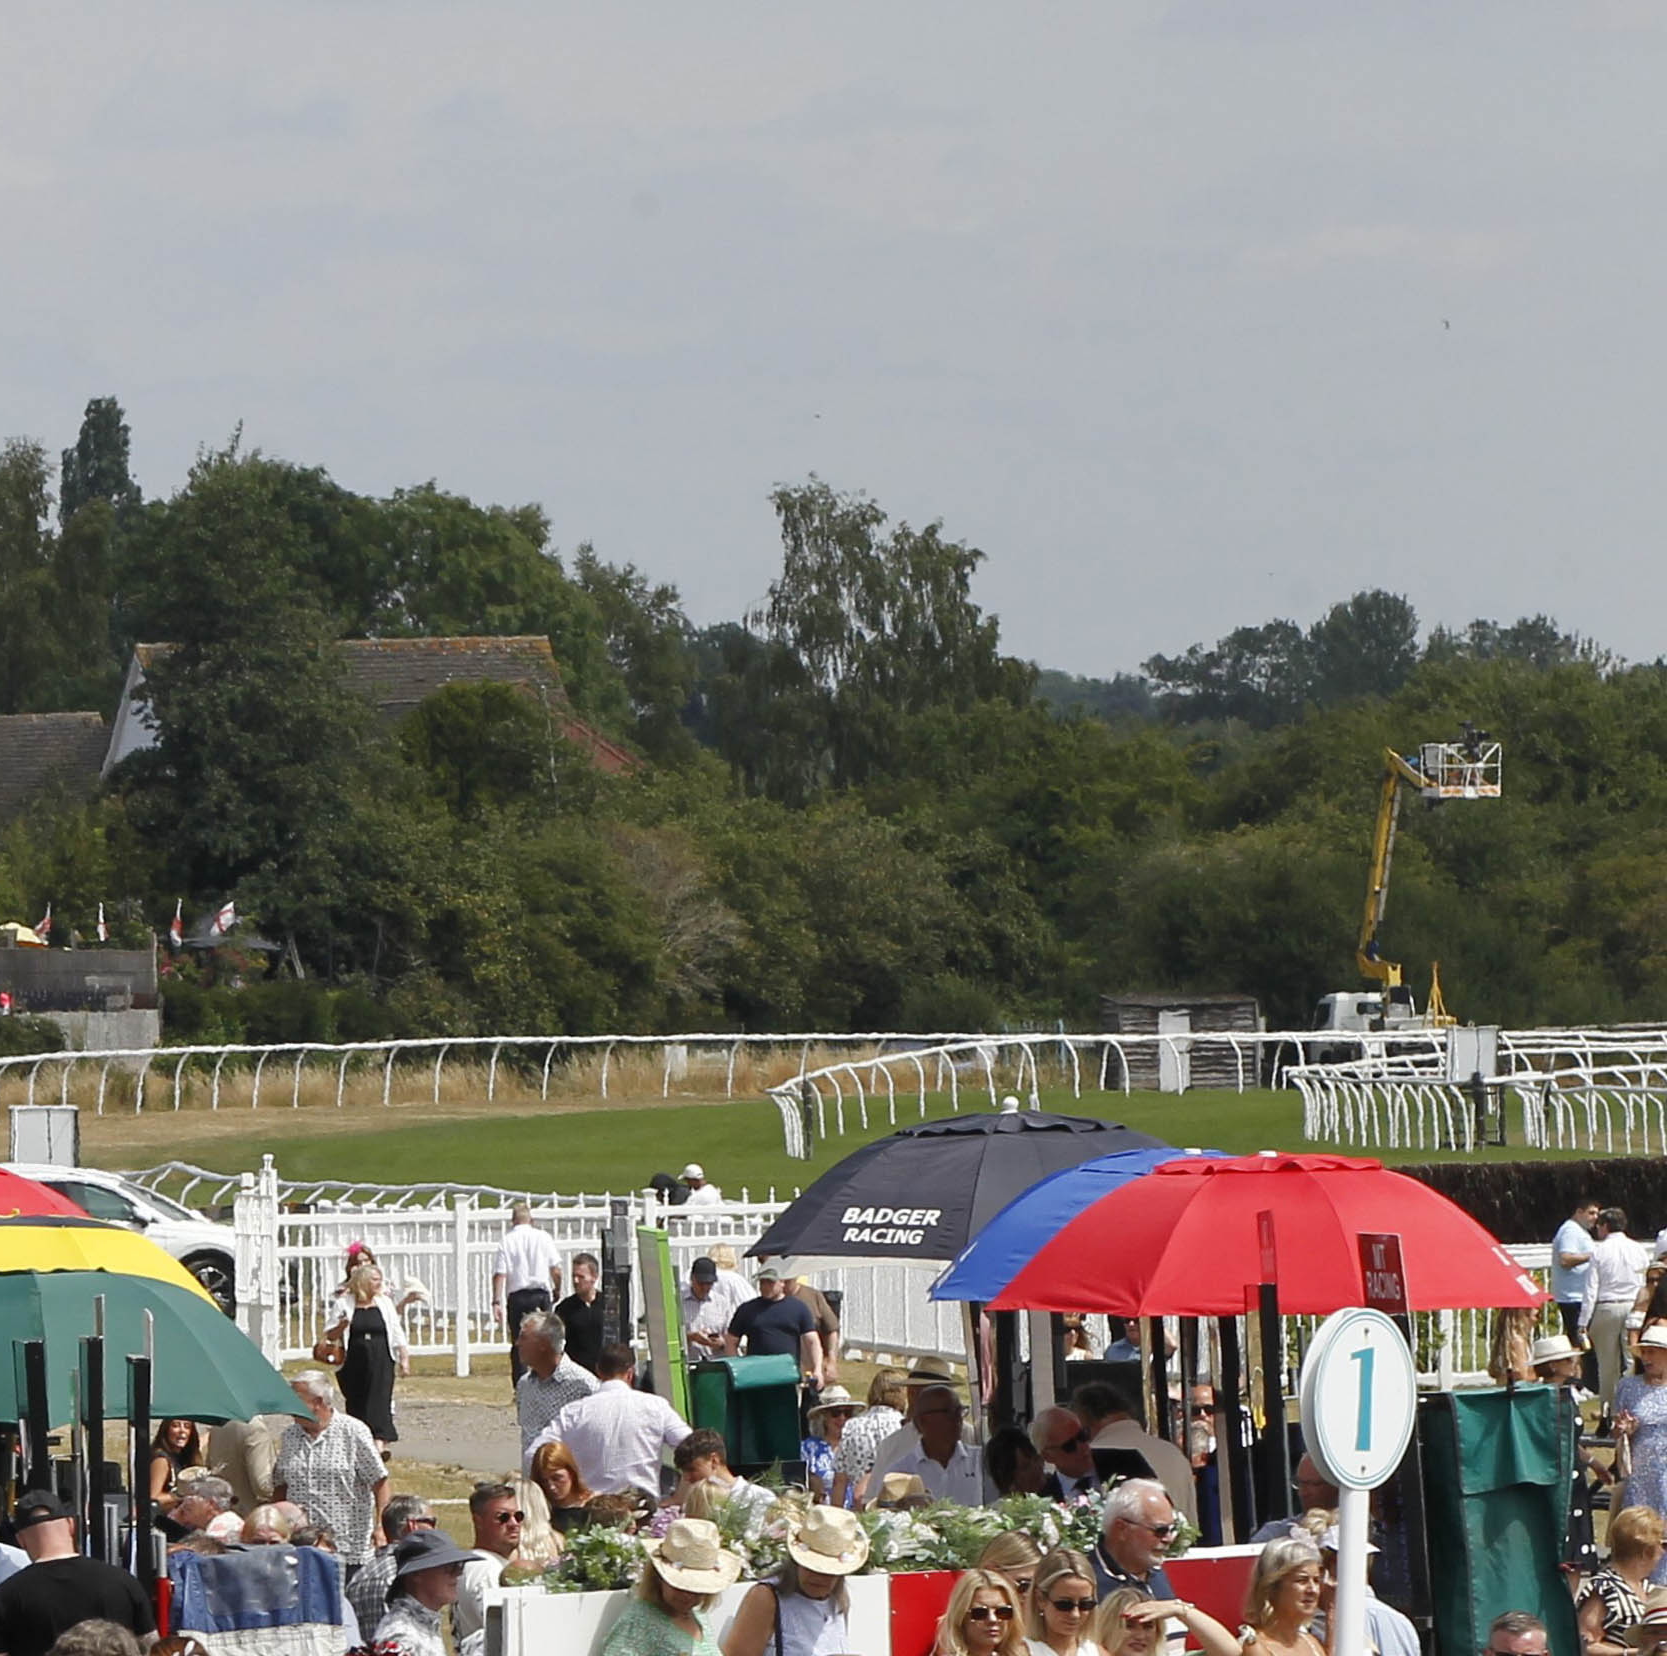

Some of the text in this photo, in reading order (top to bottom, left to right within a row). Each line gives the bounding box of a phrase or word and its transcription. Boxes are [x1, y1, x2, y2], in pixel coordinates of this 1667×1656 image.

[841, 1207, 941, 1226] BADGER
[843, 1227, 925, 1245] RACING
[1350, 1347, 1374, 1452] 1
